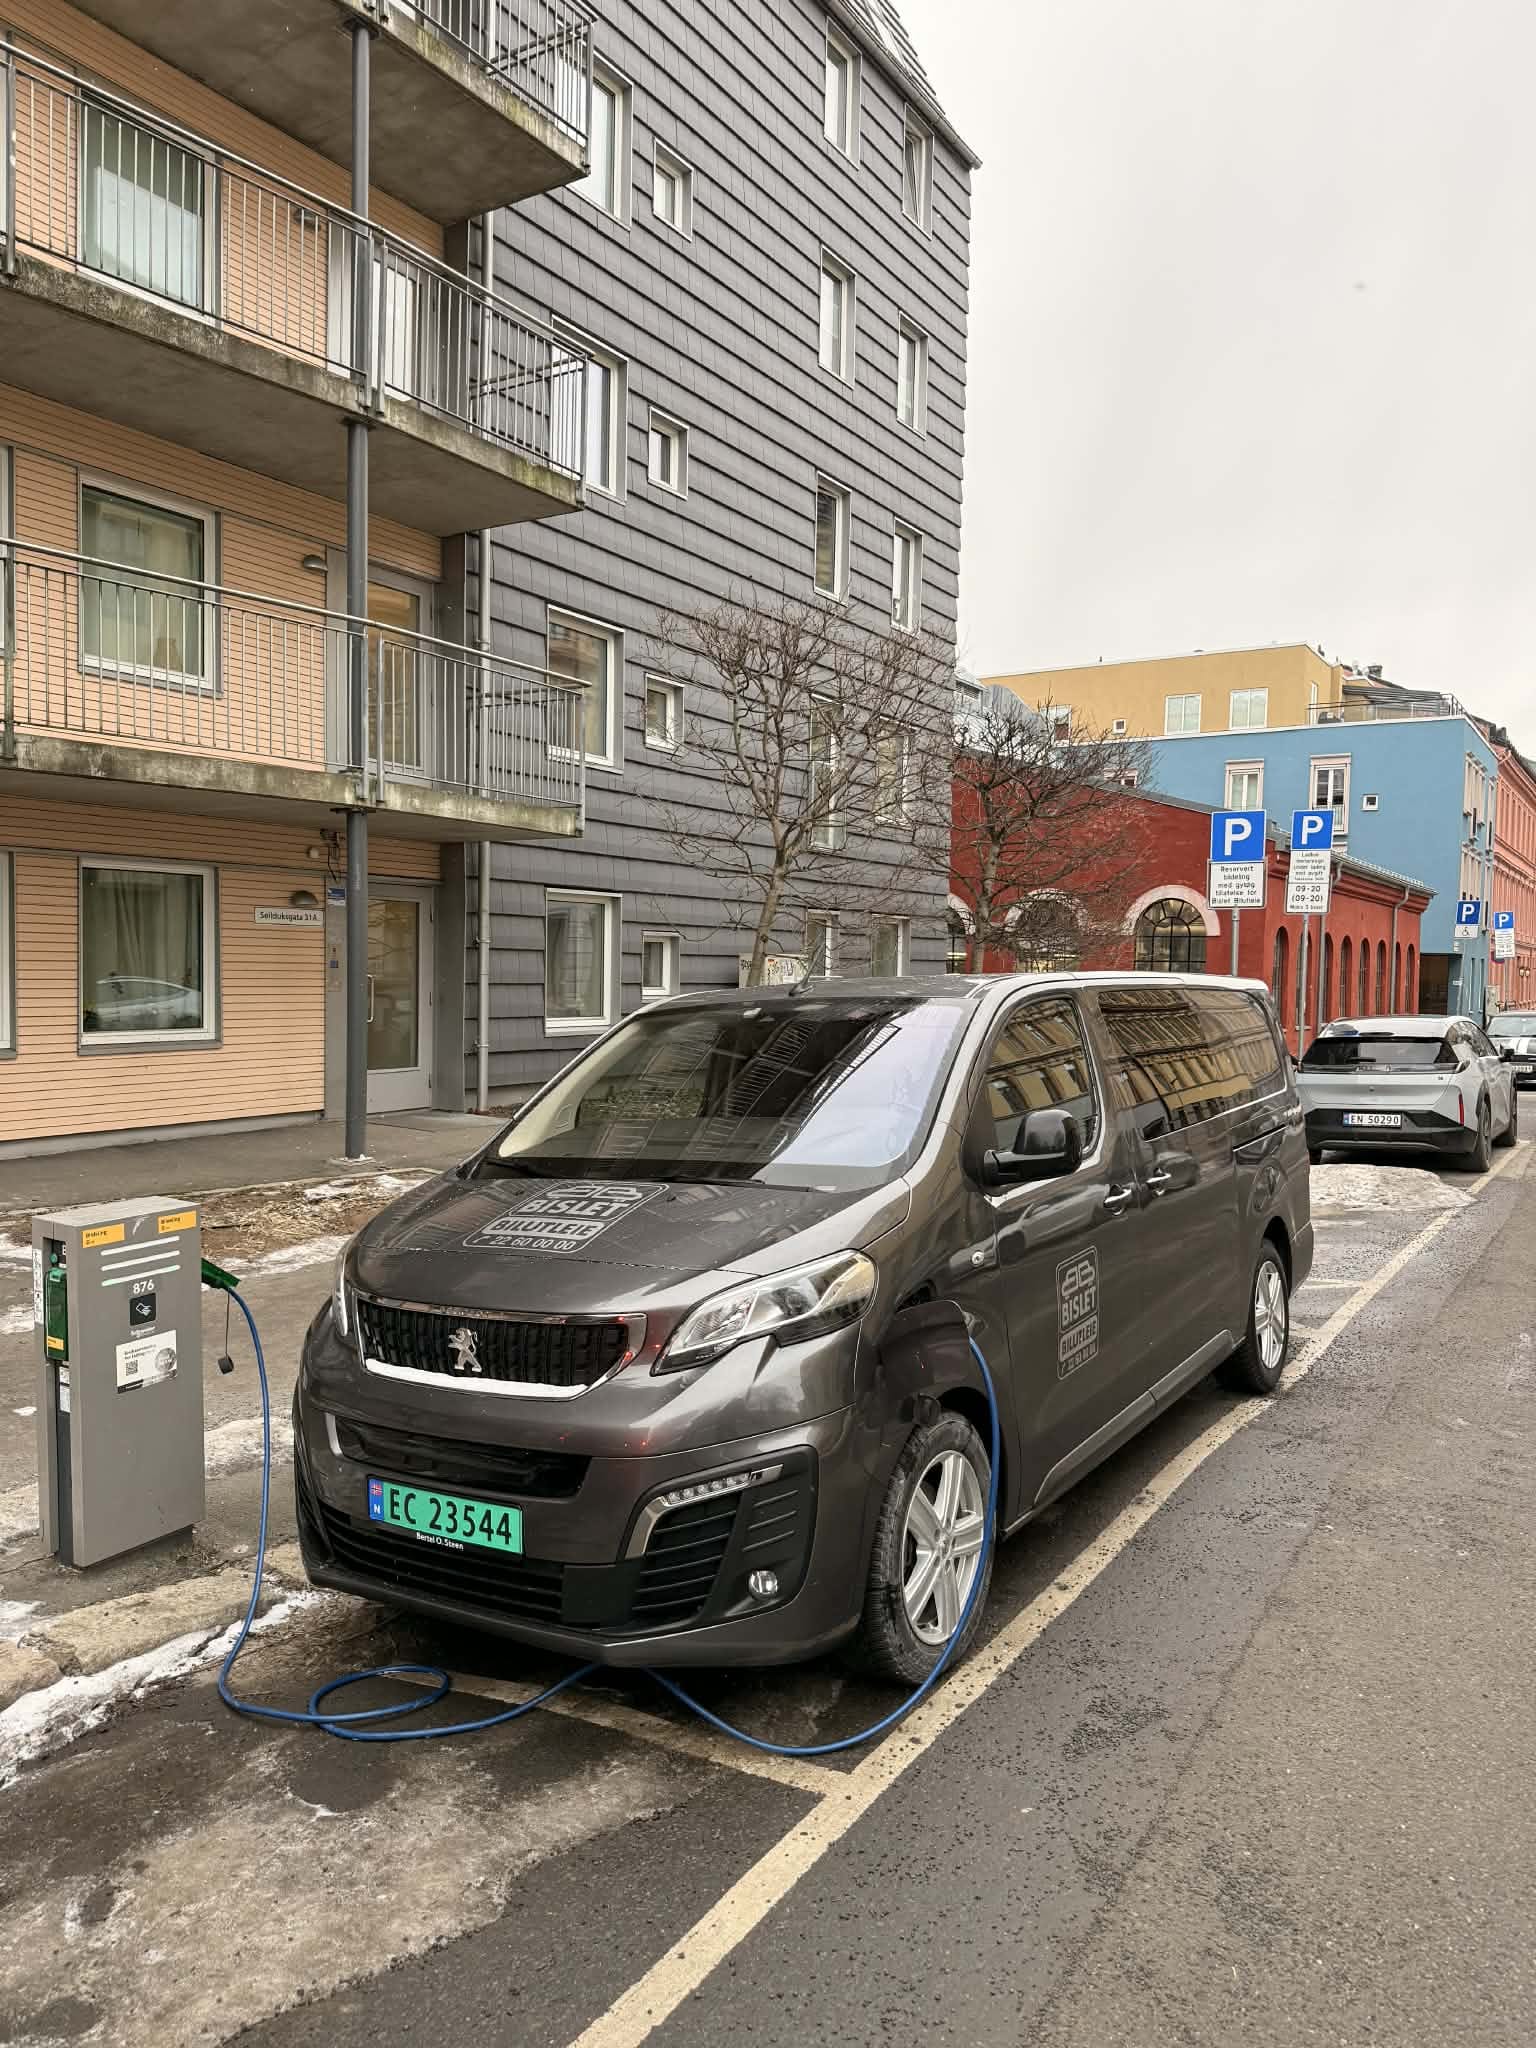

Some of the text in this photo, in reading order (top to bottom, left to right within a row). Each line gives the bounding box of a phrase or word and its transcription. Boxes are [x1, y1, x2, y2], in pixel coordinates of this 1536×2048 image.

[1224, 818, 1252, 856] P
[1301, 815, 1324, 845] P
[1461, 903, 1475, 922] P
[1498, 913, 1510, 928] P
[1350, 1114, 1399, 1125] EN 50290
[518, 1199, 630, 1217] BISLET
[490, 1219, 599, 1237] BILUTLEIE
[489, 1236, 577, 1250] 22 60 00 00
[132, 1280, 155, 1295] 876
[1061, 1286, 1096, 1326] BISLET
[373, 1504, 381, 1514] N
[389, 1487, 512, 1545] EC 23544
[416, 1532, 435, 1544] Bertel
